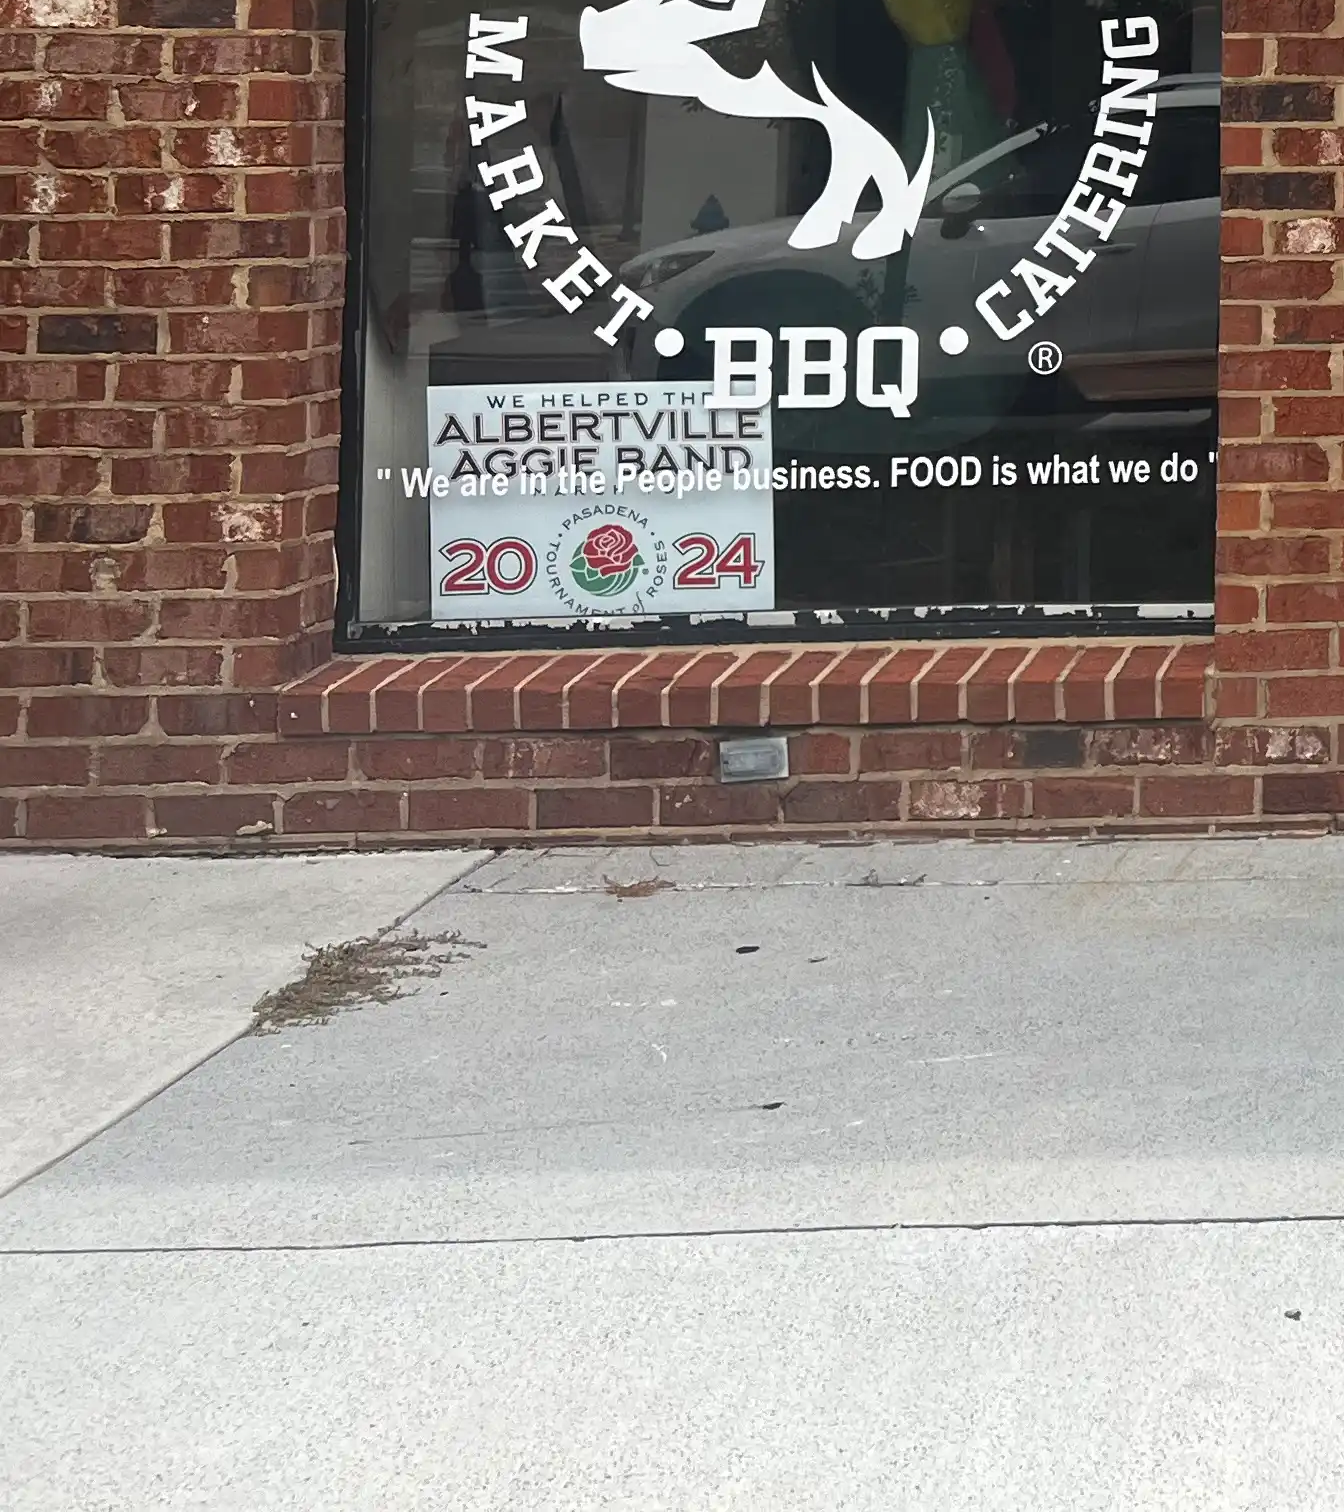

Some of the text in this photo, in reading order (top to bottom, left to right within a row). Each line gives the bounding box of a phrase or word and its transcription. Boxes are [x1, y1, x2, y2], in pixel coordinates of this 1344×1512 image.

[464, 12, 655, 348] MARKET
[974, 15, 1161, 341] CATERING
[703, 325, 920, 418] BBQ
[486, 394, 525, 409] WE
[541, 392, 649, 407] HELPED
[434, 408, 764, 446] ALBERTVILLE
[401, 467, 450, 498] We
[460, 473, 509, 497] are
[520, 465, 548, 495] in
[558, 464, 606, 494] the
[616, 462, 722, 499] People
[733, 459, 881, 491] business.
[891, 456, 983, 489] FOOD
[992, 455, 1017, 486] is
[1027, 453, 1100, 485] what
[1108, 461, 1150, 484] we
[1160, 452, 1198, 483] do
[450, 443, 754, 481] AGGIE BAND
[561, 504, 650, 531] PASADENA
[439, 536, 538, 596] 20
[645, 540, 668, 598] ROSES
[672, 532, 765, 589] 24
[632, 590, 646, 614] of
